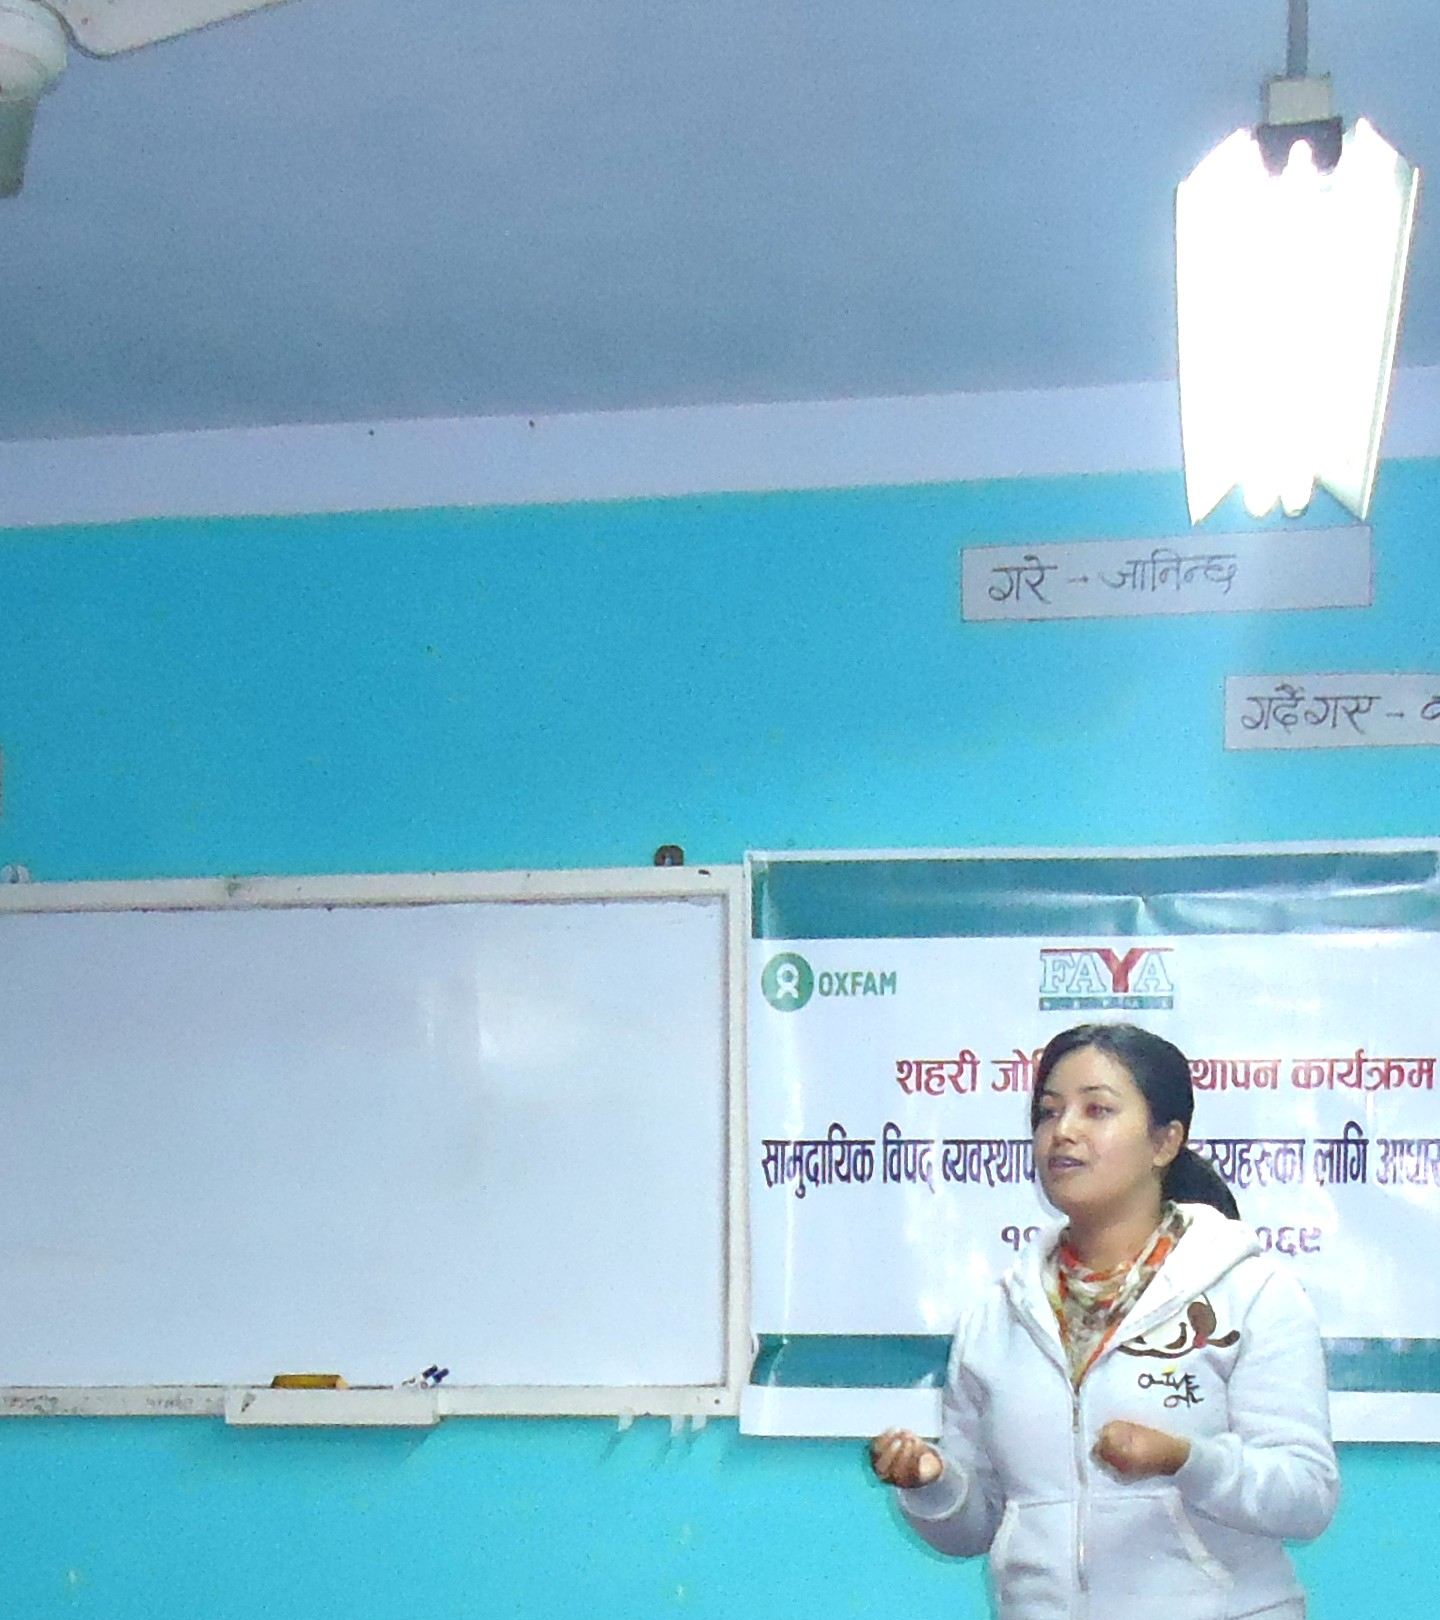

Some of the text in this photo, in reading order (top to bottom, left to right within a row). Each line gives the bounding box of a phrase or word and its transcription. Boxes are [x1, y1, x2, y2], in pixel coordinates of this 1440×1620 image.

[818, 970, 897, 998] OXFAM
[1039, 947, 1175, 993] FAYA
[896, 1049, 981, 1097] शहरी
[990, 1048, 1042, 1093] जो
[1291, 1047, 1437, 1092] कार्यक्रम
[942, 1138, 1037, 1188] व्यवस्थाप
[1313, 1120, 1370, 1186] लागि
